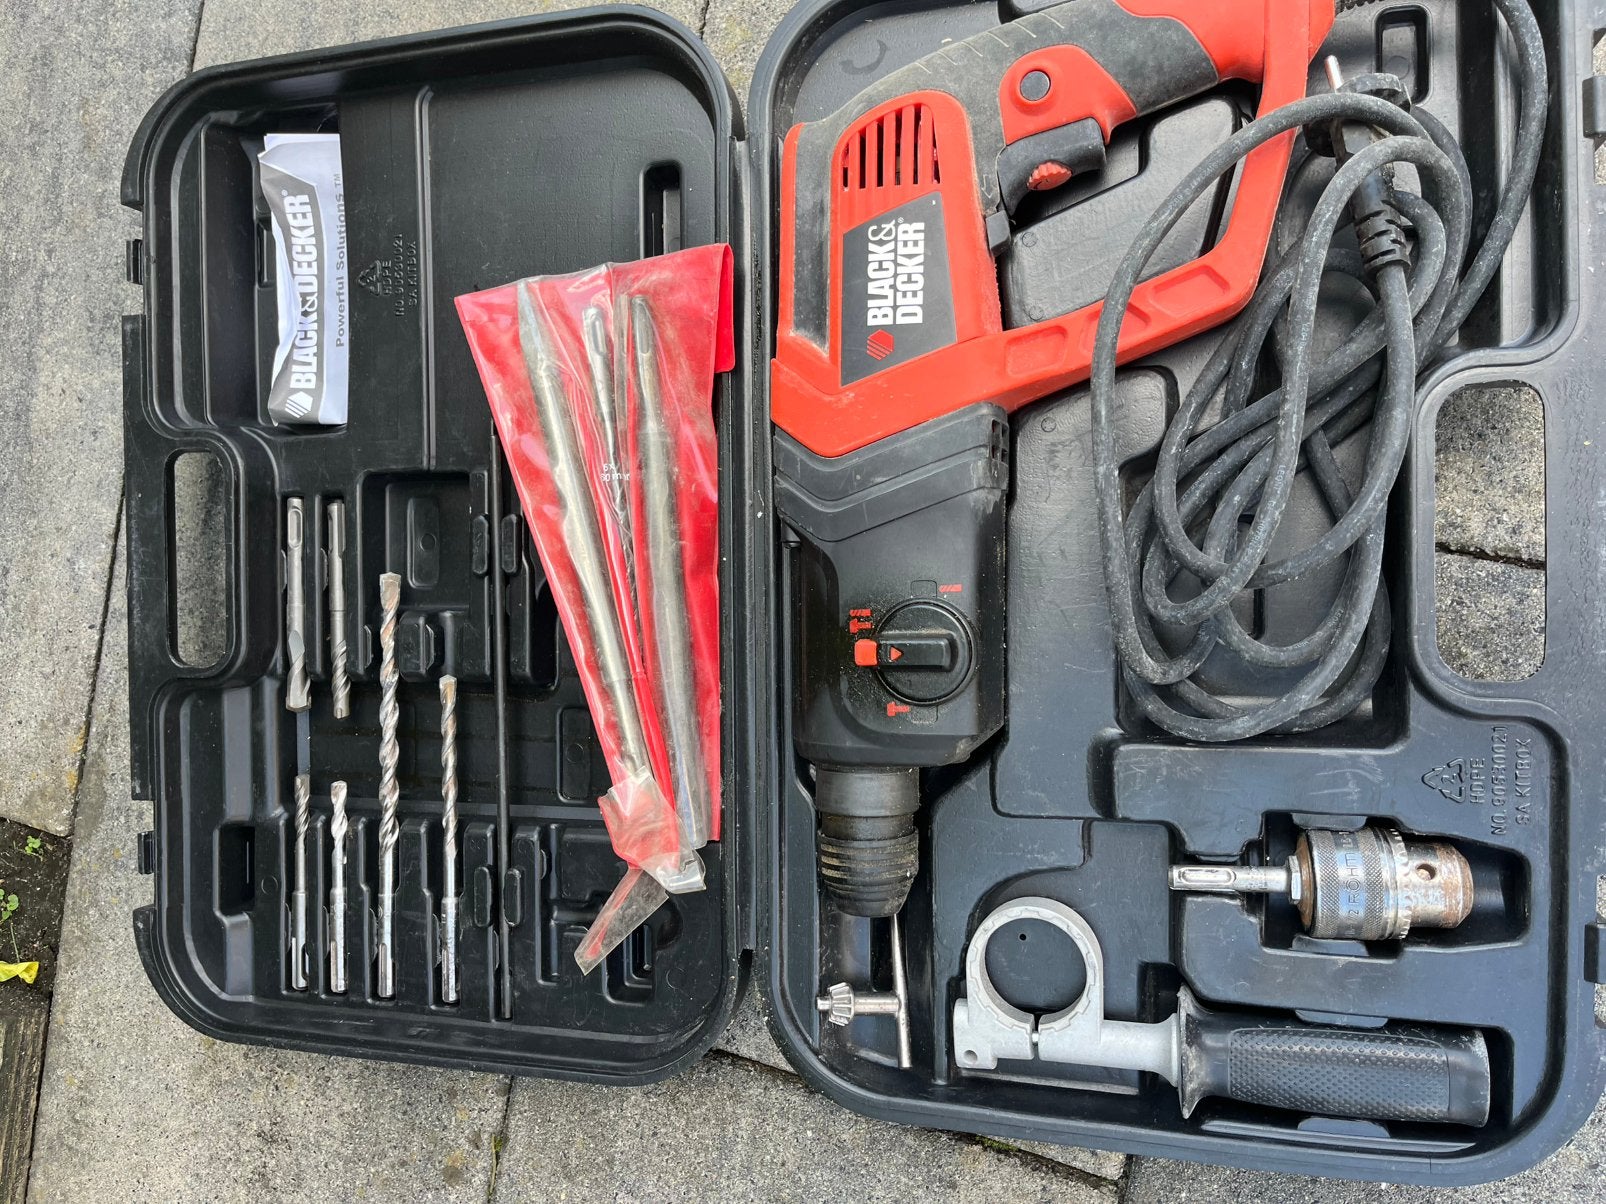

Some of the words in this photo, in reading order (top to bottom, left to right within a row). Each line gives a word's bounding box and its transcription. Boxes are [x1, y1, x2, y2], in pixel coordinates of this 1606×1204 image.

[334, 192, 346, 270] Solutions
[382, 260, 393, 296] HDPE
[406, 240, 418, 286] KITBOX
[895, 222, 926, 325] DECKER
[334, 275, 346, 348] Powerful
[407, 289, 418, 306] SA
[1470, 757, 1486, 804] HDPE
[1515, 737, 1532, 798] KITBOX
[1515, 802, 1532, 826] SA
